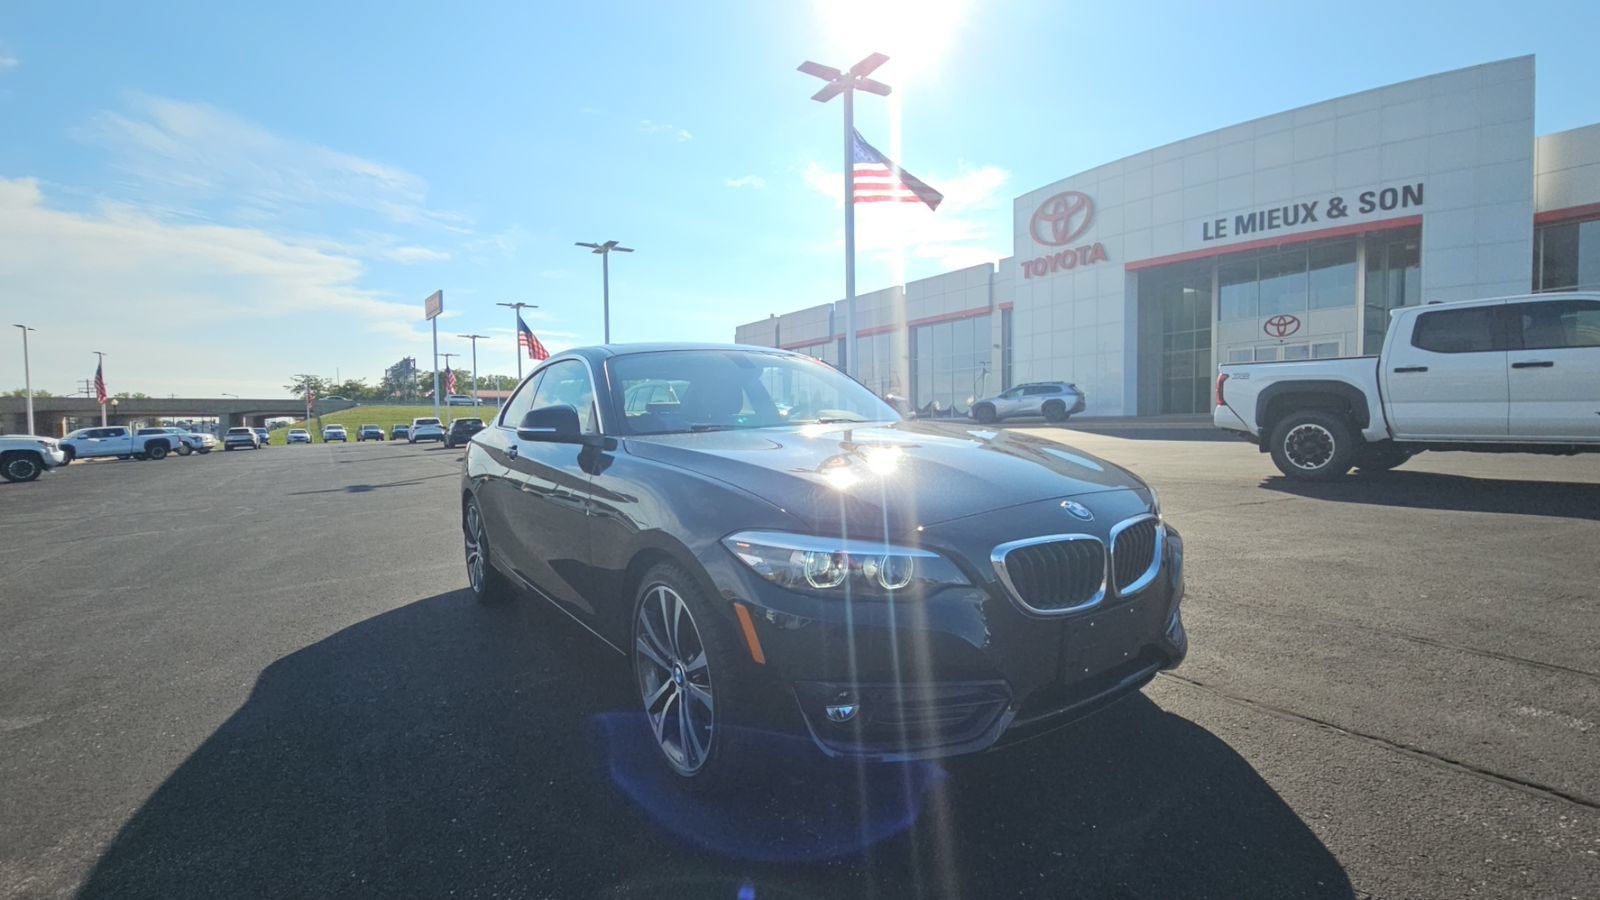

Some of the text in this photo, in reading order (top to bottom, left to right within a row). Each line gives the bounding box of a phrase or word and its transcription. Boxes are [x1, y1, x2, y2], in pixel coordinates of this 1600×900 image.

[1202, 182, 1424, 241] LE MIEUX & SON
[1021, 242, 1109, 279] TOYOTA
